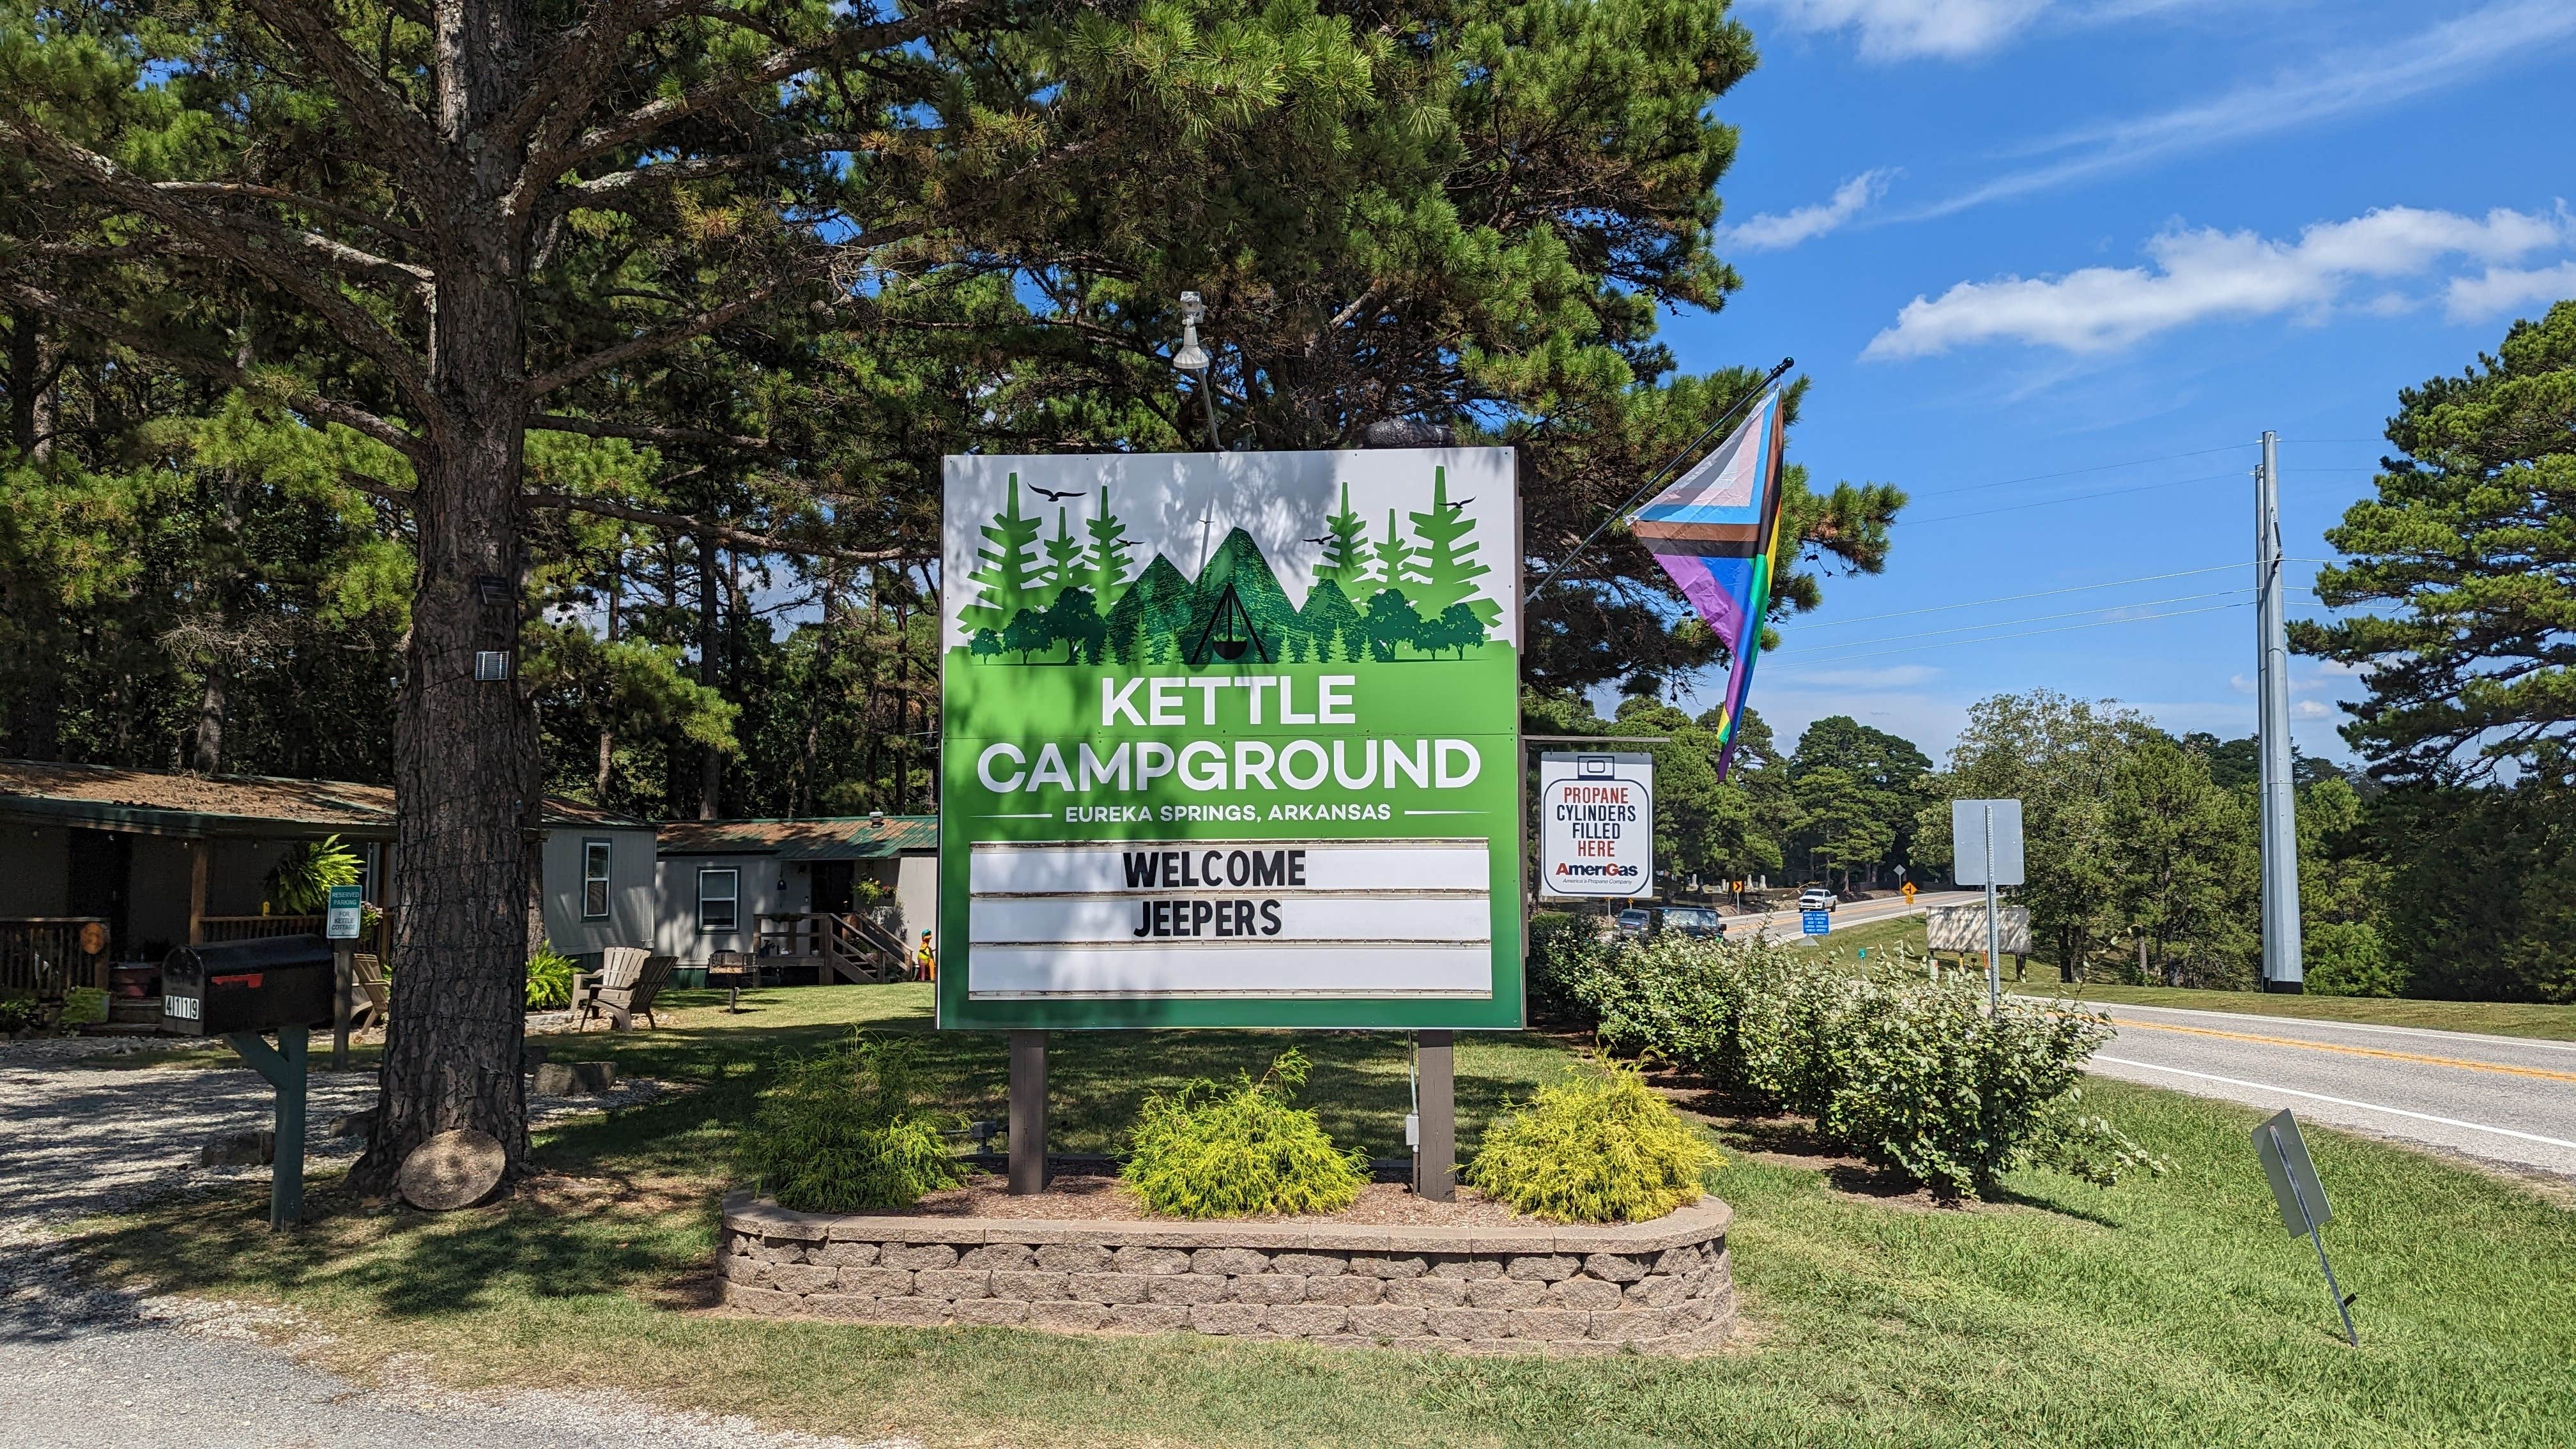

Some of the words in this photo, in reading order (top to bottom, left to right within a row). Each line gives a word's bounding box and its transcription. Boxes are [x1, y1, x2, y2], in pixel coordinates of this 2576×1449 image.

[1101, 675, 1356, 726] KETTLE
[977, 738, 1483, 793] CAMPGROUND
[1564, 786, 1629, 804] PROPANE
[1066, 806, 1153, 822] EUREKA
[1160, 804, 1262, 824] SPRINGS,
[1268, 803, 1391, 821] ARKANSAS
[1556, 804, 1636, 822] CYLINDERS
[1572, 822, 1620, 839] FILLED
[1578, 840, 1615, 857] HERE
[1123, 850, 1306, 888] WELCOME
[1556, 862, 1638, 877] AmeriGas
[1133, 899, 1282, 937] JEEPERS
[166, 996, 197, 1018] 4119
